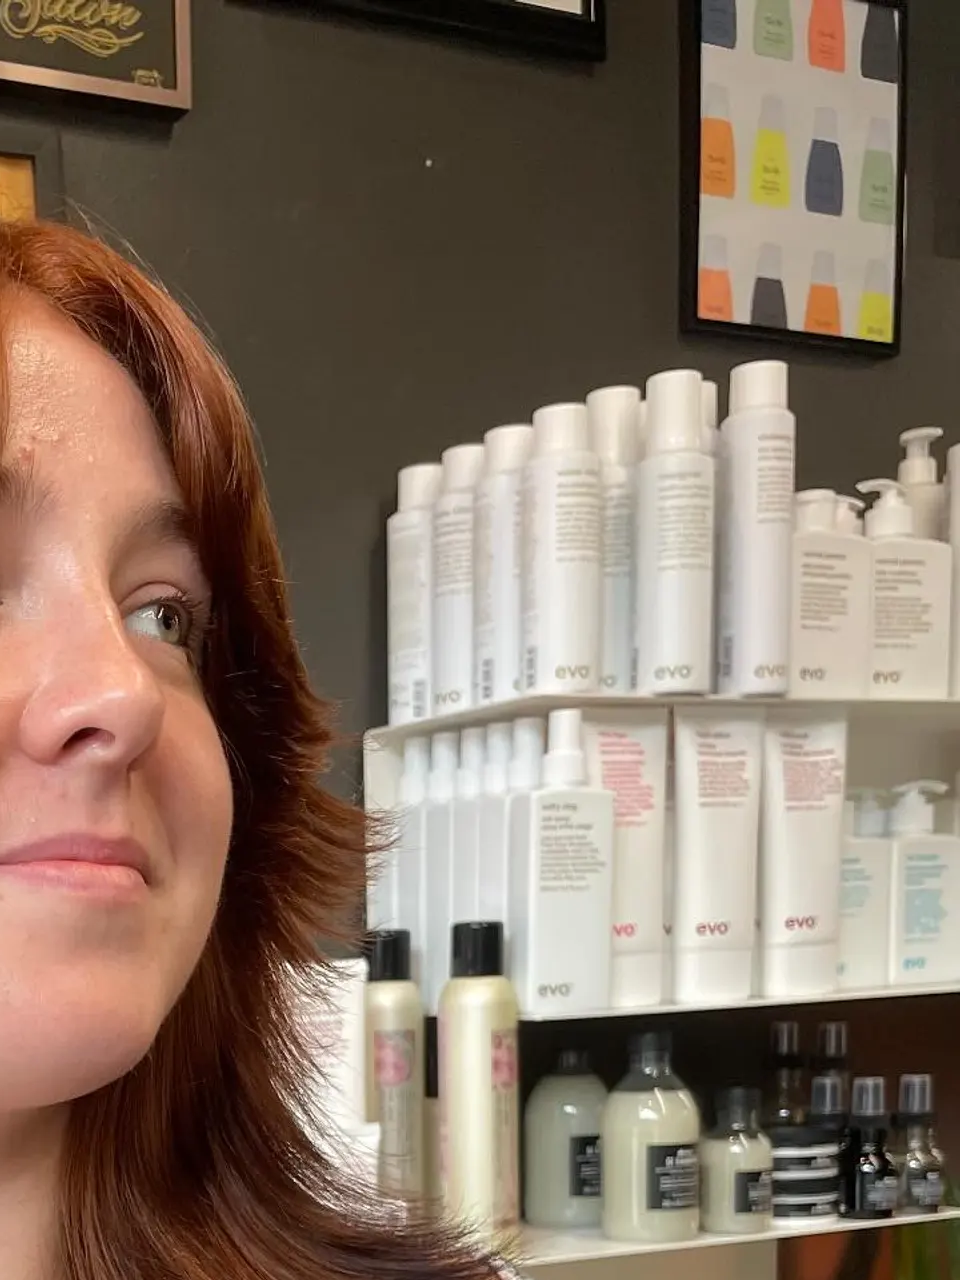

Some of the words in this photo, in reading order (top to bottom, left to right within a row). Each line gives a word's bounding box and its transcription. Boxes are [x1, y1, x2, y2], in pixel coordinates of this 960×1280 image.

[555, 665, 590, 680] evo
[654, 664, 692, 681] evo
[613, 923, 636, 937] vo
[695, 921, 729, 936] evo
[784, 915, 817, 930] evo
[538, 983, 572, 997] evo
